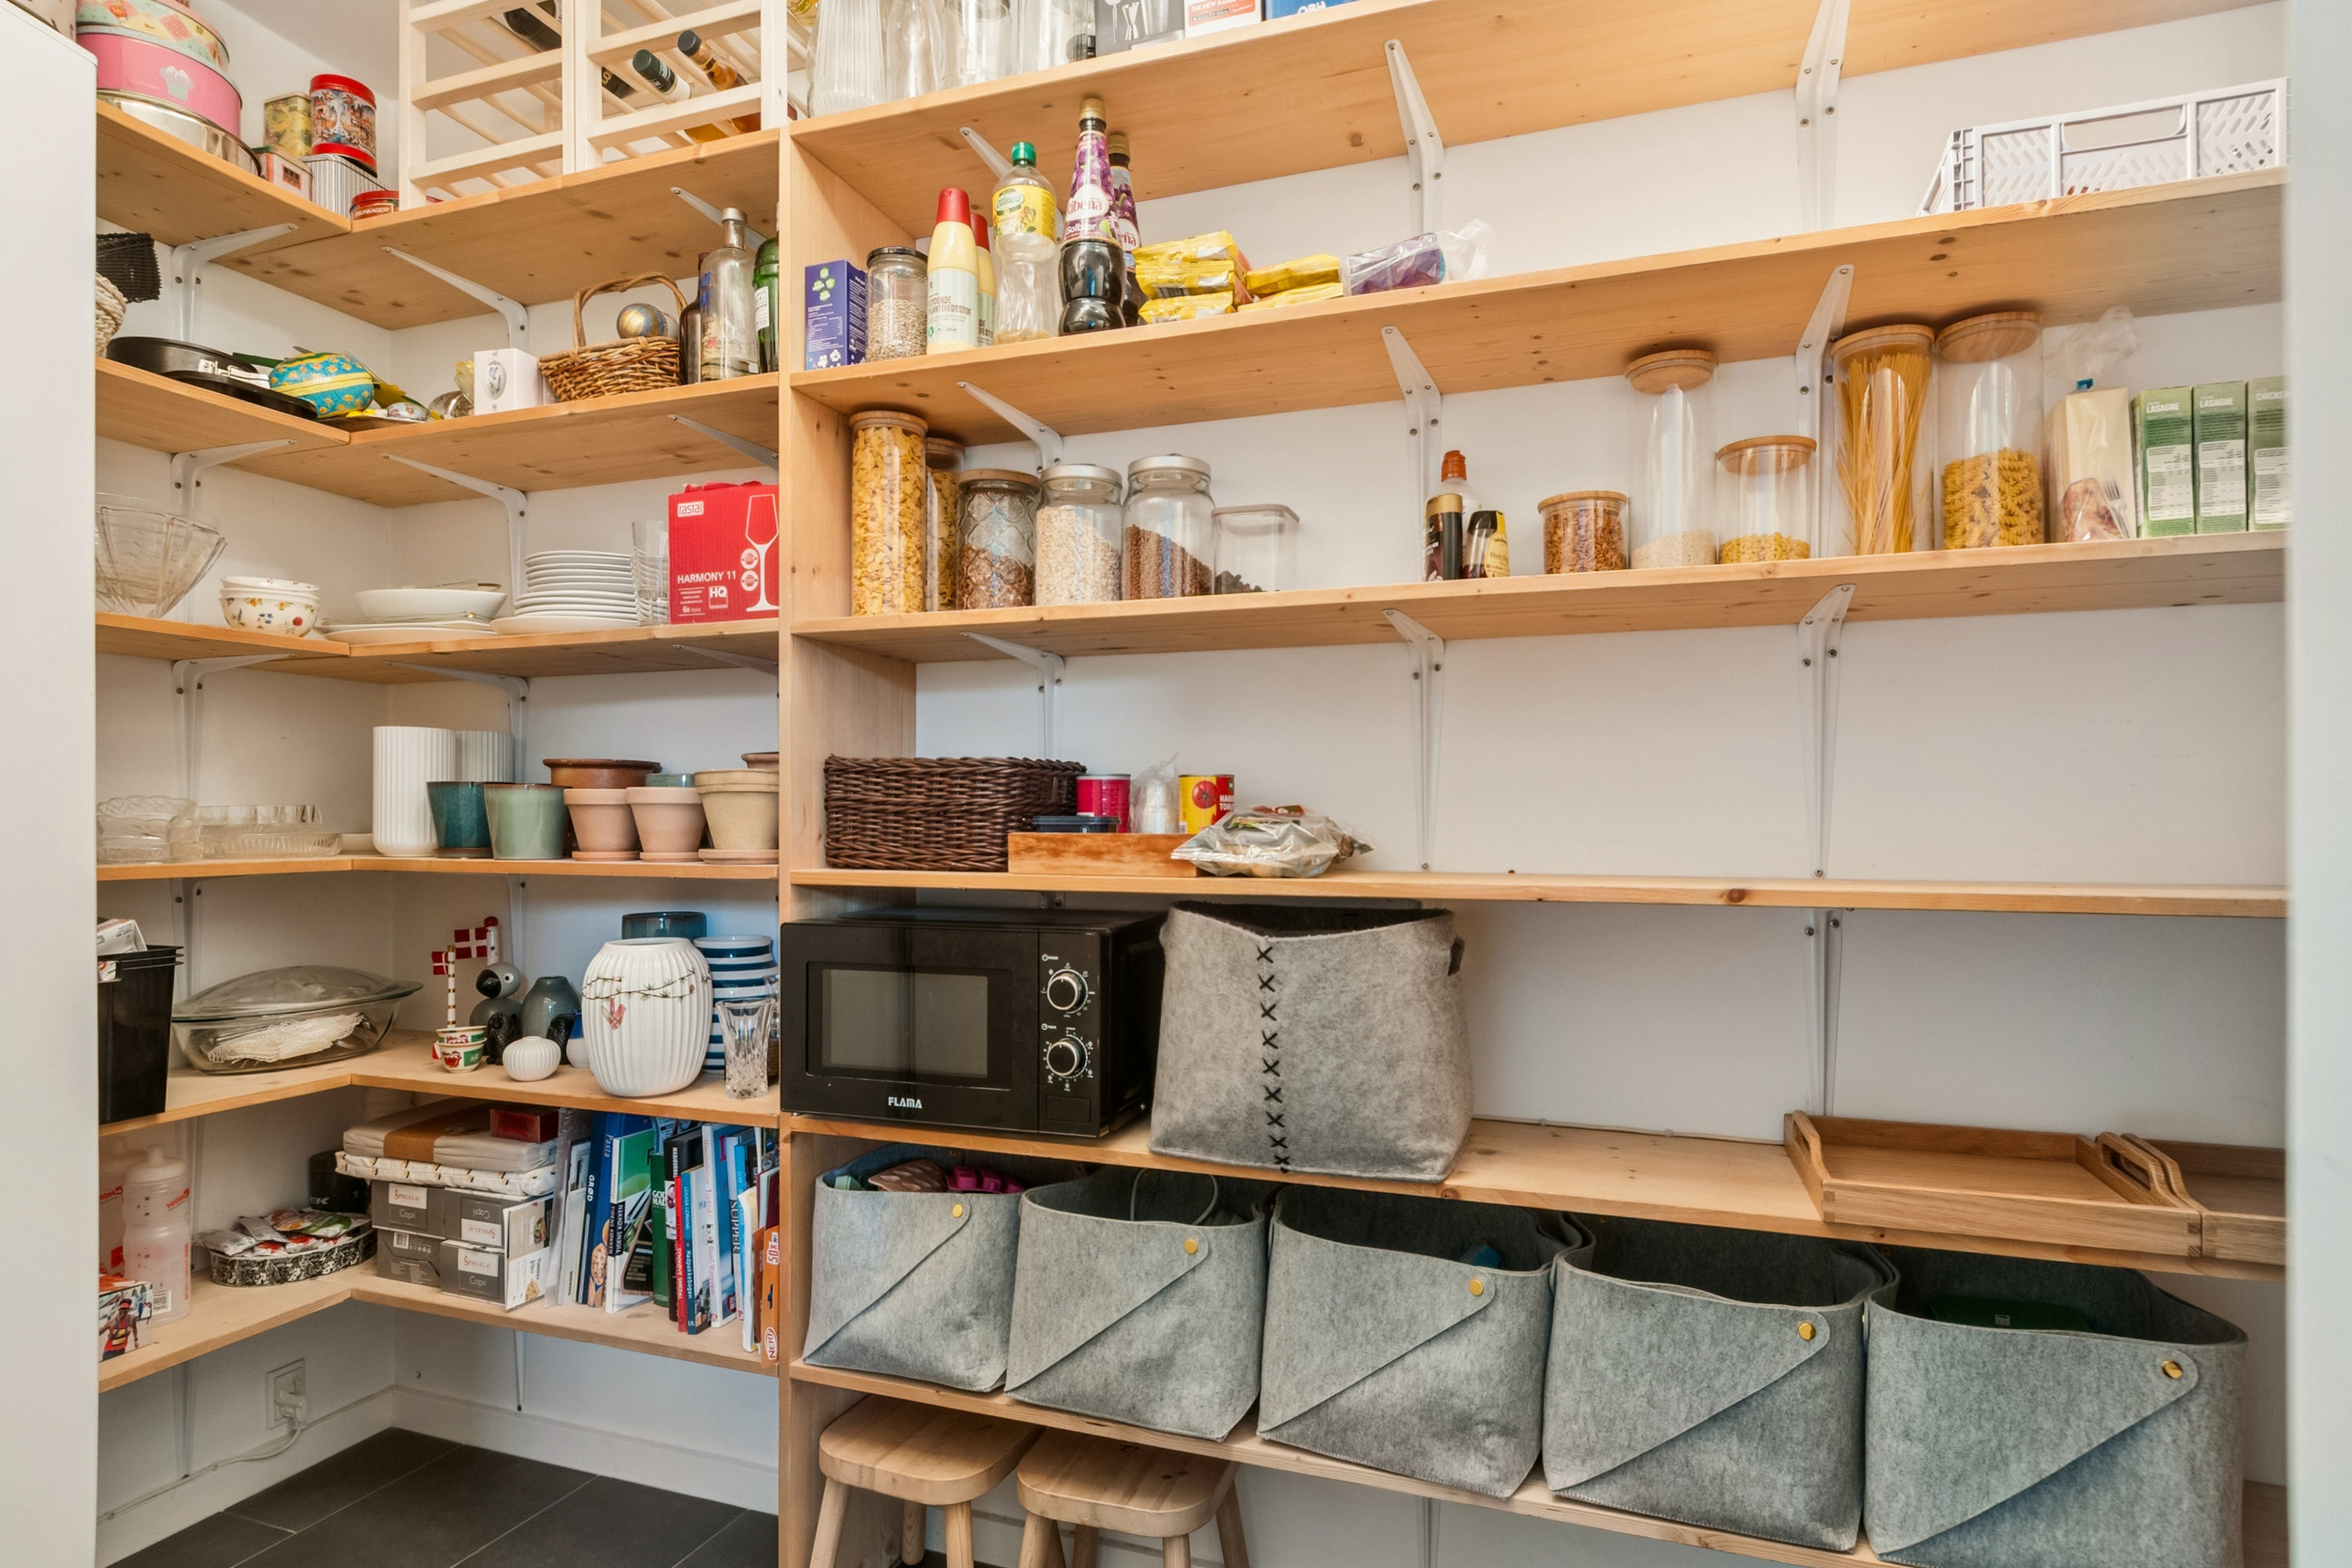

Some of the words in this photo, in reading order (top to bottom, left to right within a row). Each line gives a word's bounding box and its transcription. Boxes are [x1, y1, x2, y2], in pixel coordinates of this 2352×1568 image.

[2147, 402, 2180, 414] LASAGNE
[2200, 397, 2234, 408] LASAGNE
[677, 572, 724, 584] HARMONY
[727, 570, 736, 580] 11
[710, 587, 727, 597] HQ
[887, 1096, 923, 1109] FLAMA
[604, 1134, 614, 1158] Pasta
[399, 1208, 416, 1221] Capri
[473, 1207, 491, 1219] Capri
[730, 1200, 741, 1254] SUPPER
[469, 1275, 487, 1288] Capri
[765, 1328, 775, 1359] NERF
